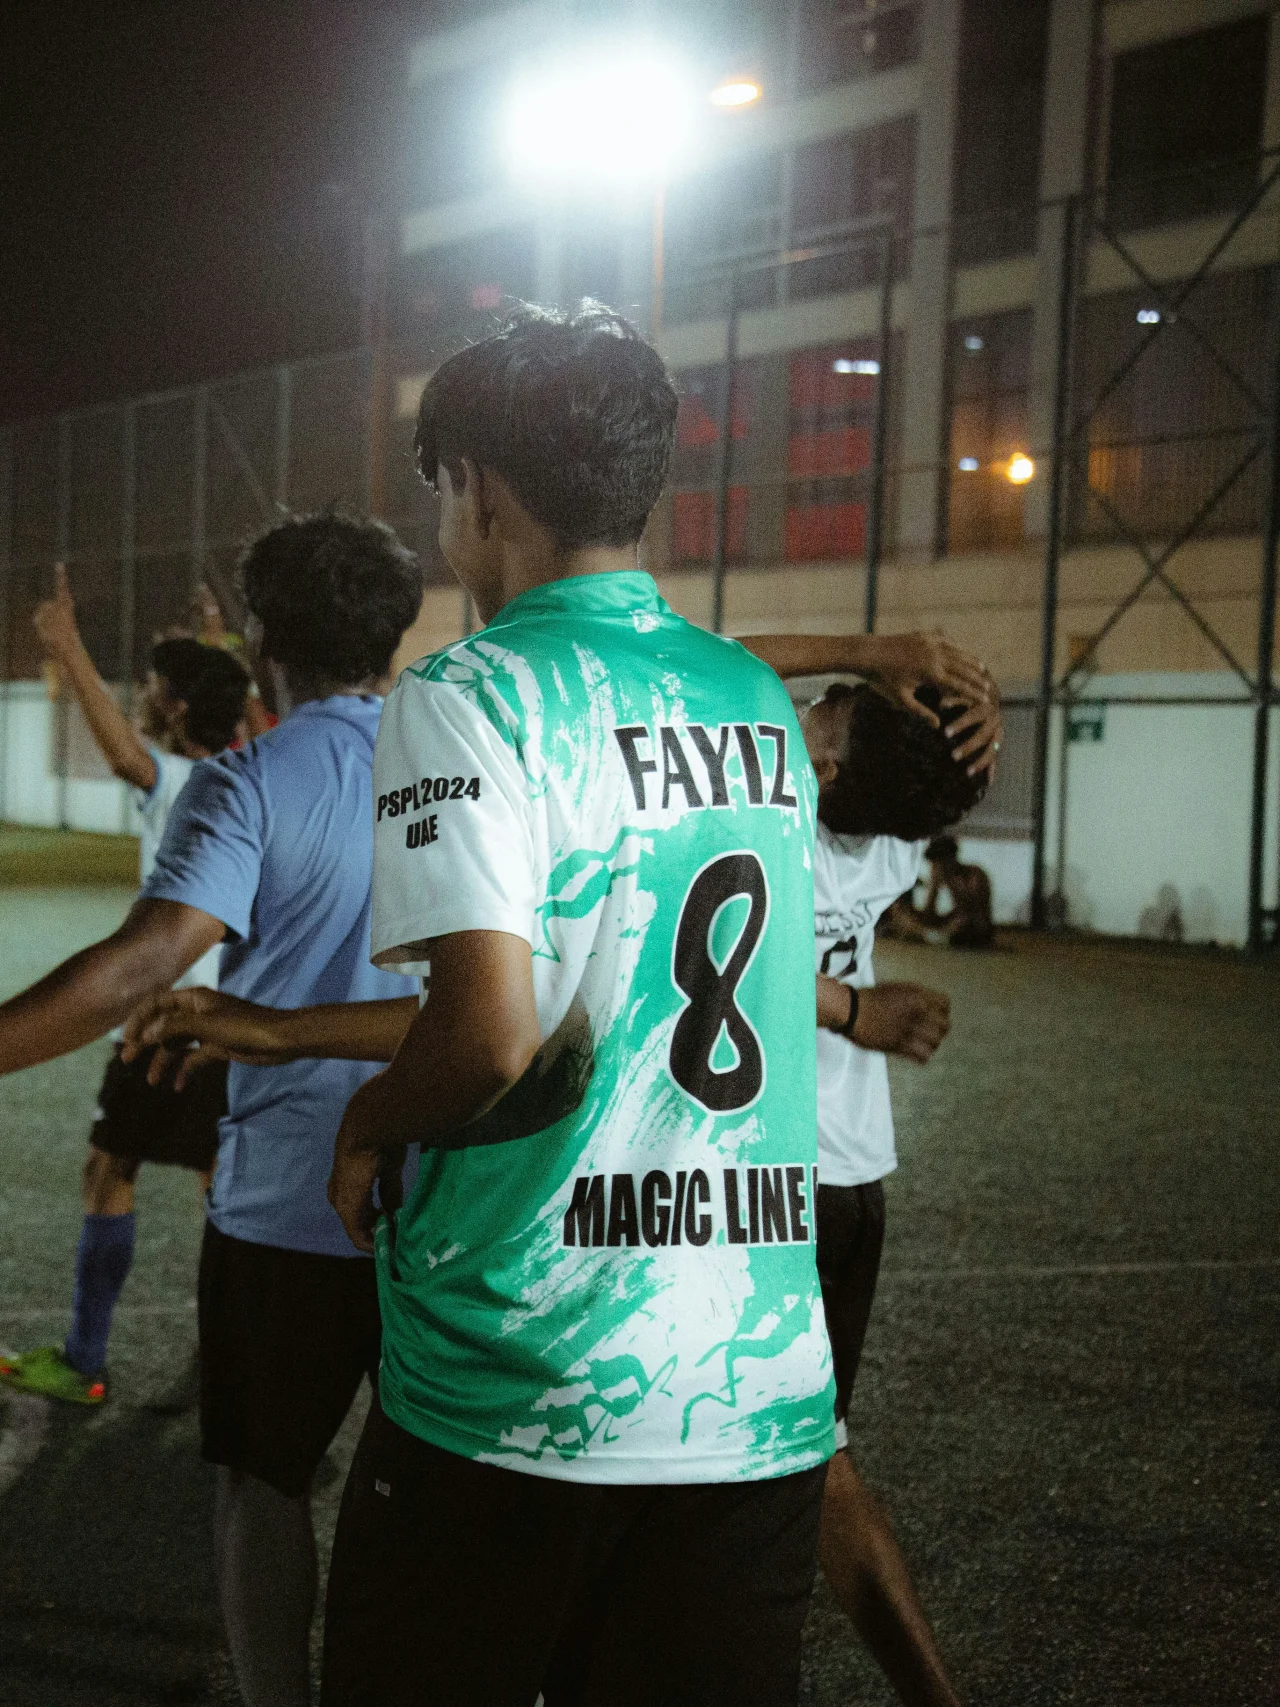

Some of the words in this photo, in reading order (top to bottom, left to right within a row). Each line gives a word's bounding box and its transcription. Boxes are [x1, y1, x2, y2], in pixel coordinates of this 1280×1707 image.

[377, 783, 421, 823] PSPL
[420, 777, 480, 802] 2024
[613, 724, 798, 810] FAYIZ
[406, 814, 438, 849] UAE
[670, 852, 768, 1114] 8
[563, 1168, 713, 1248] MAGIC
[723, 1166, 809, 1245] LINE
